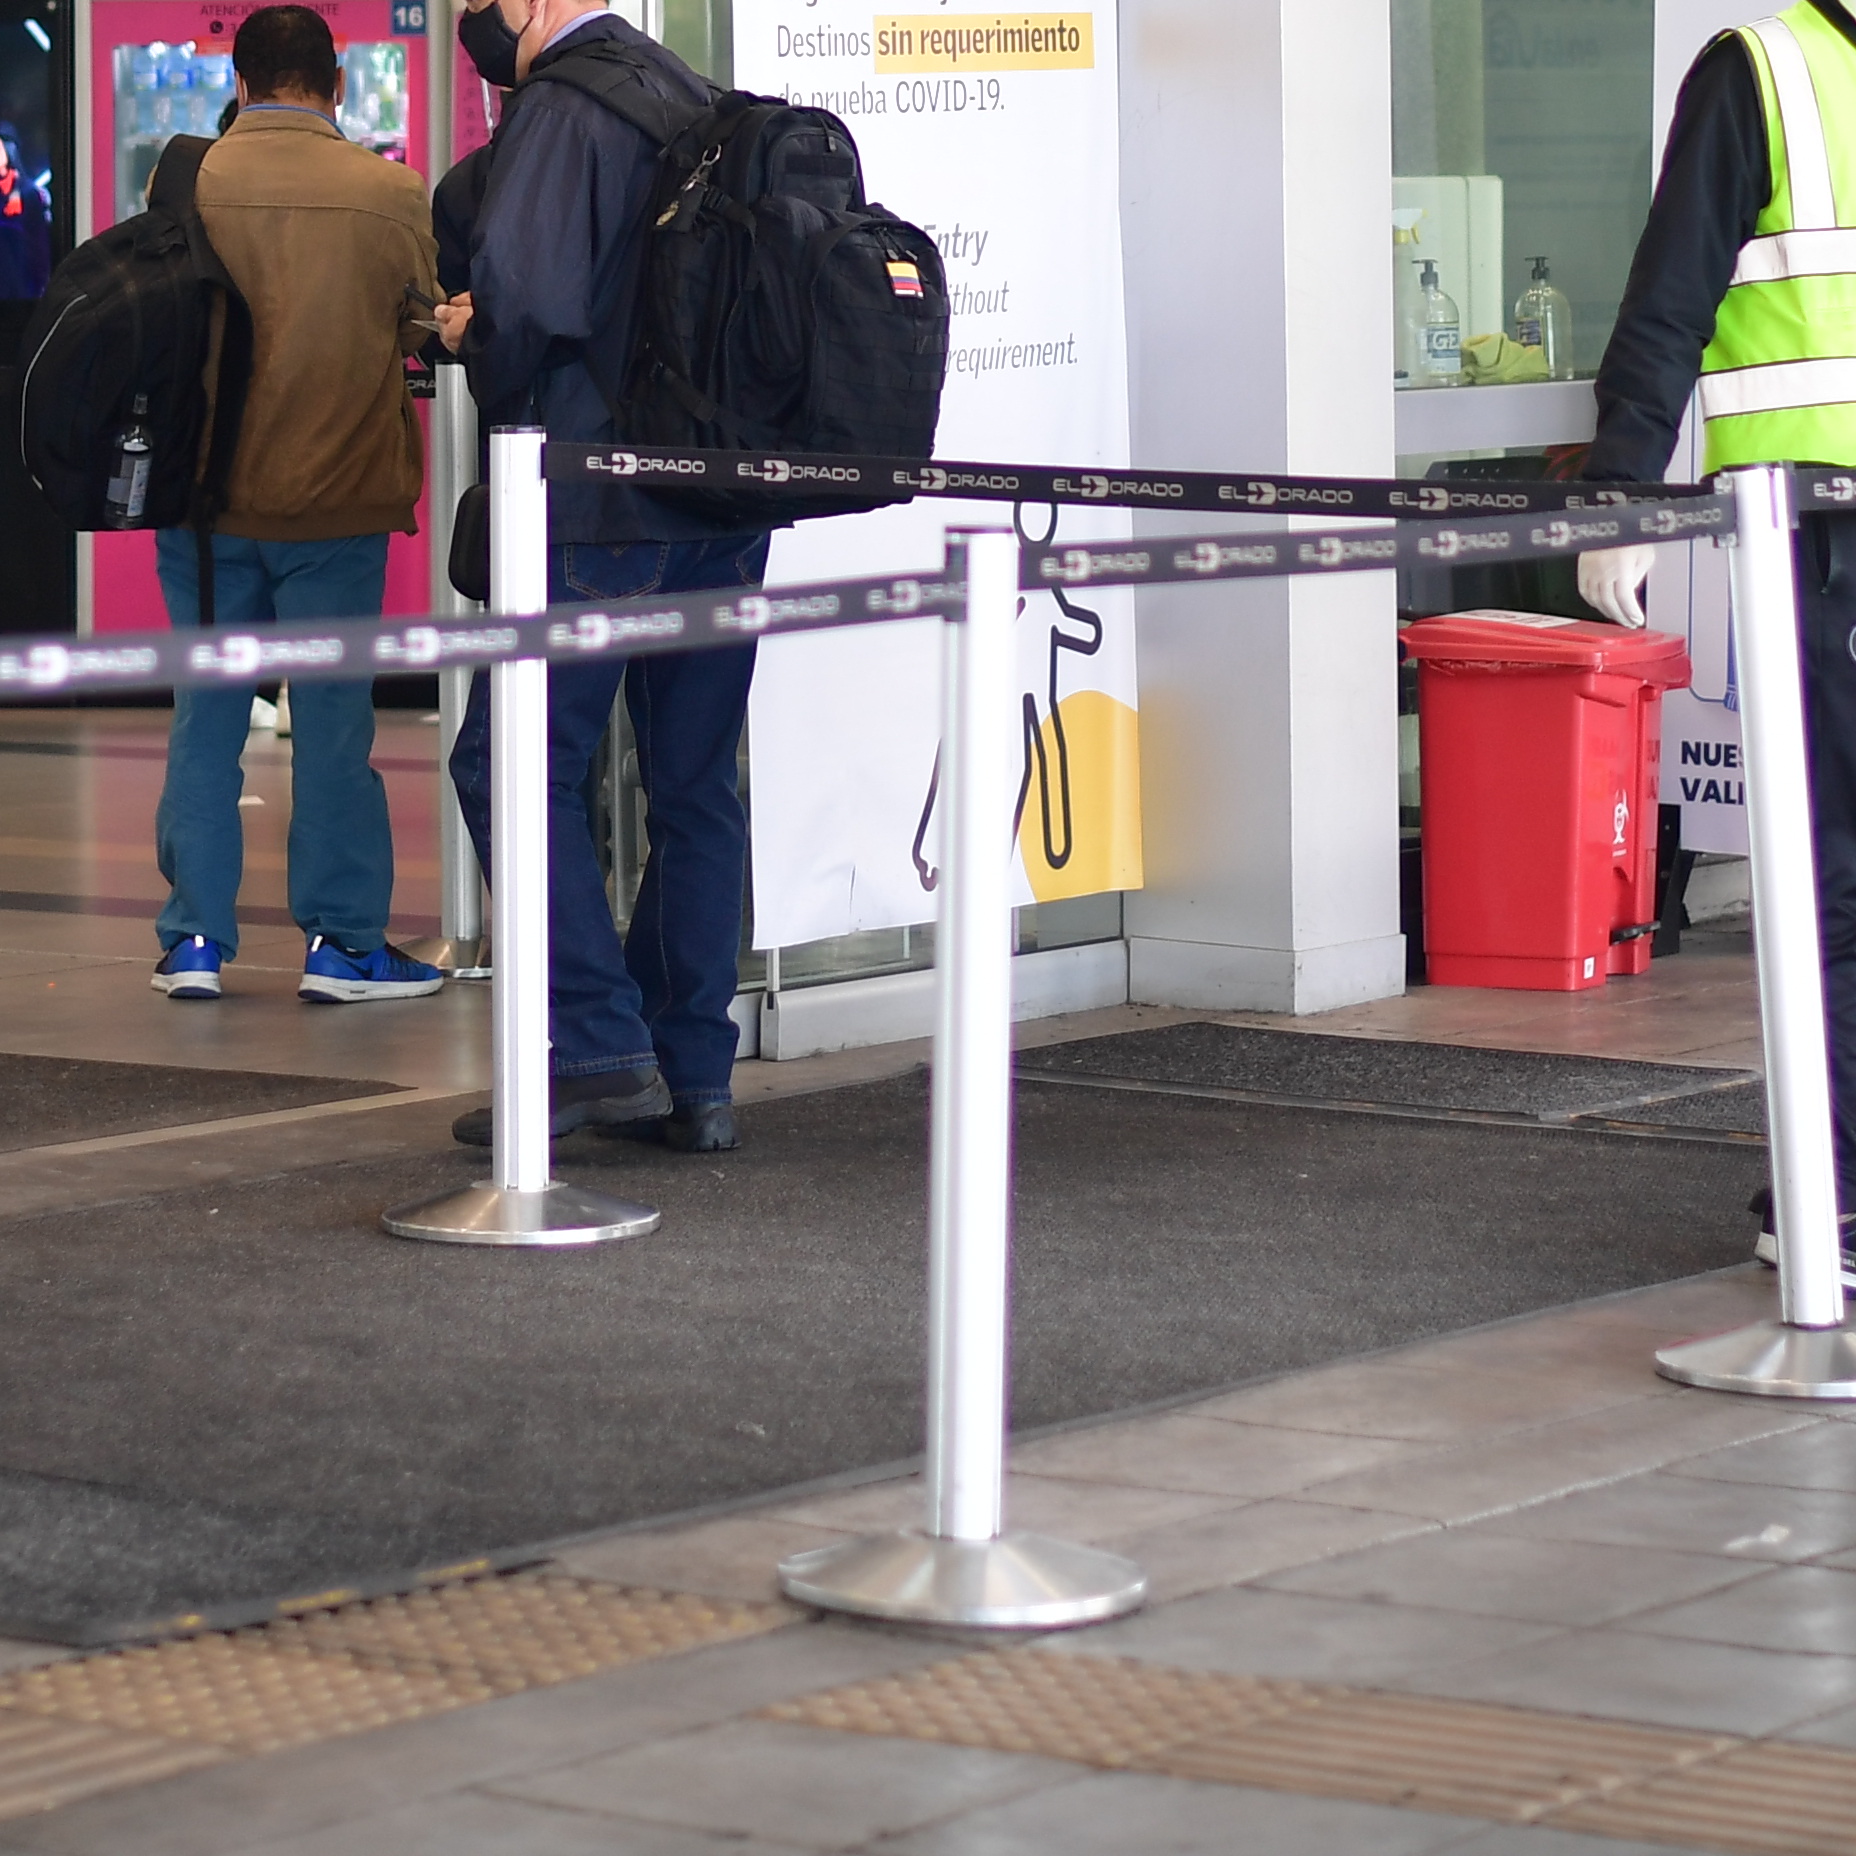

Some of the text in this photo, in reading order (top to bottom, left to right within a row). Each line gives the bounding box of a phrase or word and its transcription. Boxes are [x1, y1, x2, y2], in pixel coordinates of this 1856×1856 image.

[395, 6, 424, 28] 16
[777, 20, 1080, 62] Destinos sin requerimiento
[779, 79, 1005, 115] de prueba COVID-19.
[948, 281, 1009, 315] ithout
[944, 332, 1078, 379] requirement.
